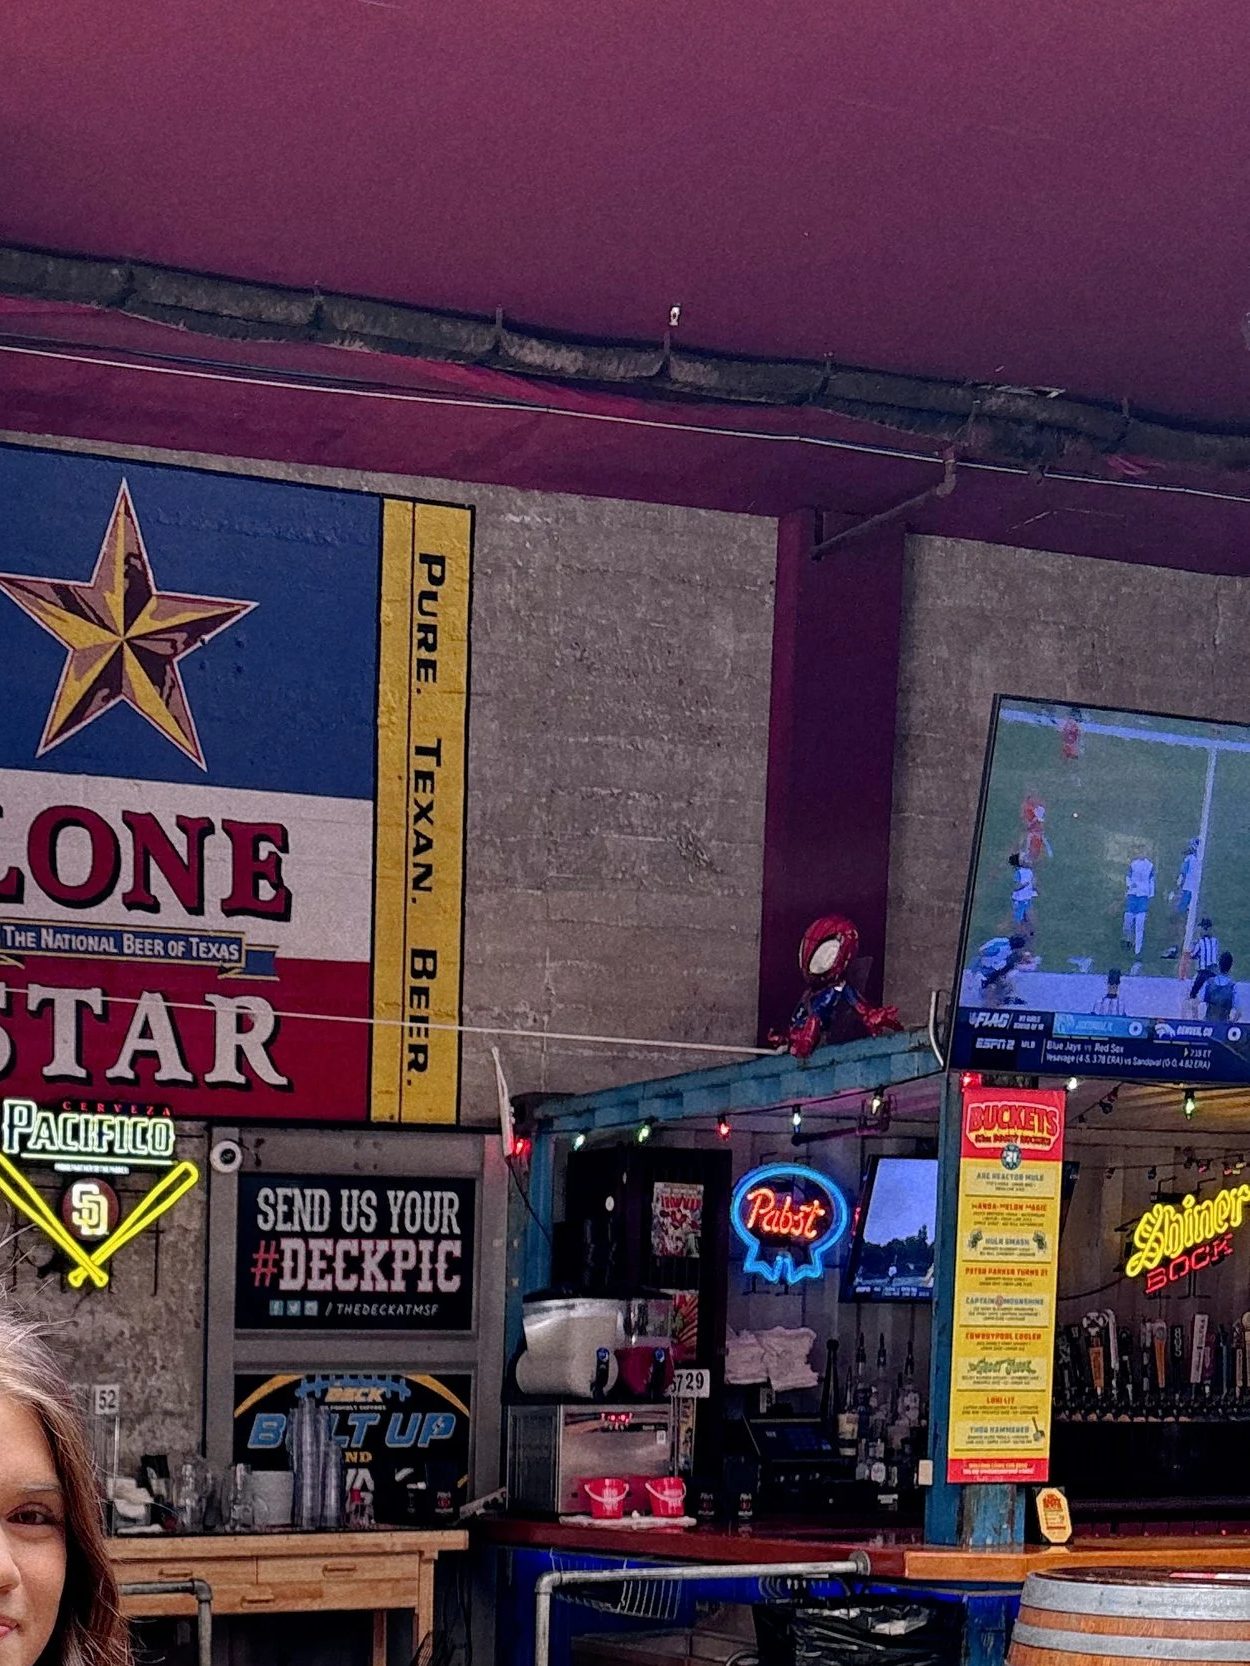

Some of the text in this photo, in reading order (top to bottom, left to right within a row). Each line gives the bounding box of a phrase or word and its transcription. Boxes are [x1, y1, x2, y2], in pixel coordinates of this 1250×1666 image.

[405, 553, 447, 1088] PURE. TEXAN. BEER.
[3, 926, 240, 961] THE NATIONAL BEER OF TEXAS
[1046, 1040, 1064, 1050] Blue
[1065, 1042, 1081, 1053] Jays
[1094, 1043, 1110, 1053] Red
[2, 1098, 176, 1157] PACIFICO
[62, 1101, 171, 1117] CERVEZA
[968, 1104, 1059, 1137] BUCKETS
[256, 1186, 462, 1235] SEND US YOUR
[746, 1187, 826, 1240] Pabst
[1125, 1183, 1250, 1278] Shiner
[250, 1236, 463, 1293] #DECKPIC
[1145, 1232, 1234, 1295] BOCK
[247, 1411, 457, 1449] BLT UP
[344, 1451, 373, 1464] ND
